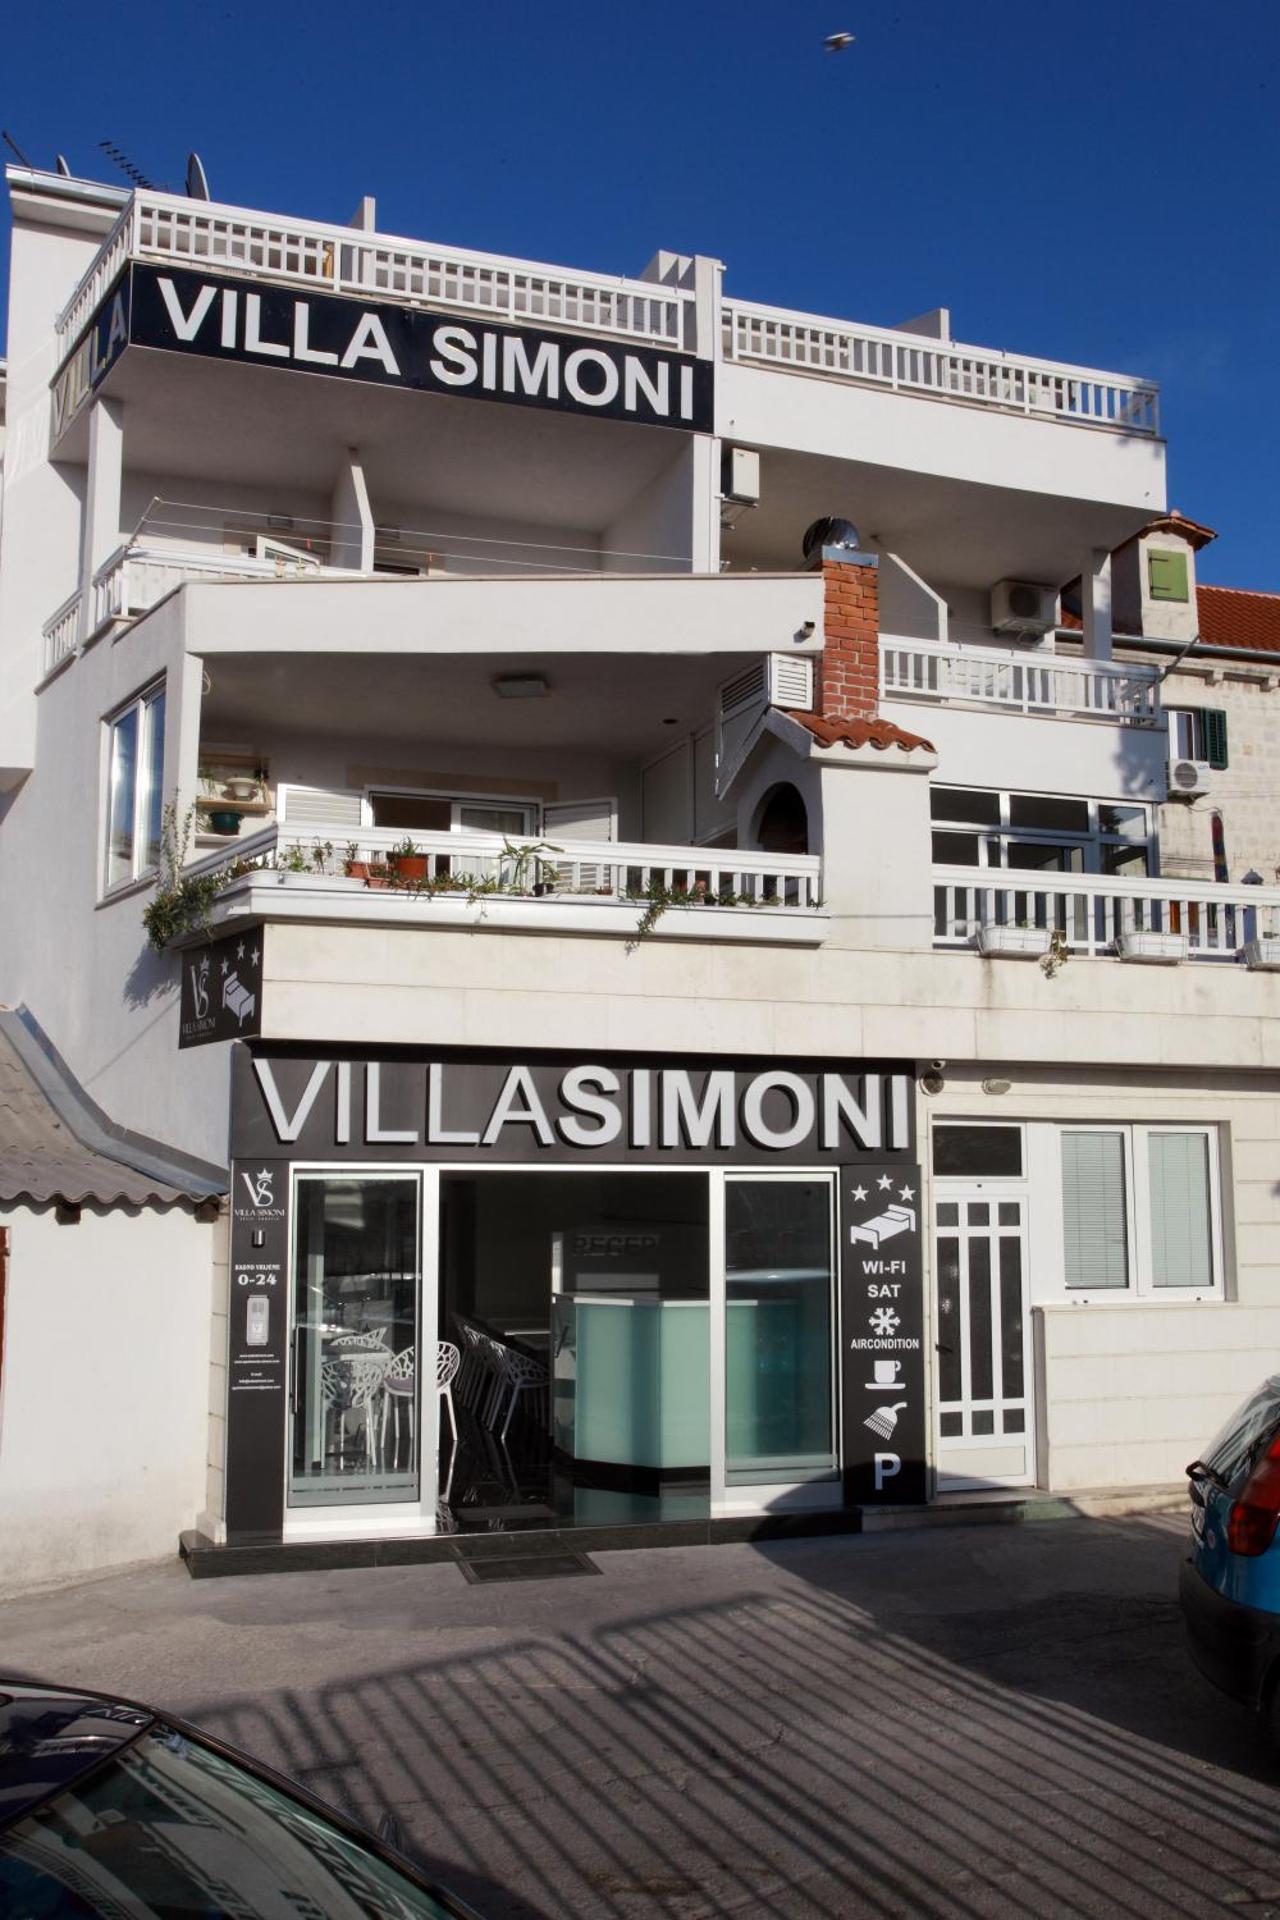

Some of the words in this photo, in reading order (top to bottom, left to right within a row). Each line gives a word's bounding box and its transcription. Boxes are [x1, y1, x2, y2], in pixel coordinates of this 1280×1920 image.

[156, 277, 401, 376] VILLA
[430, 326, 693, 420] SIMONI
[862, 1260, 906, 1274] WI-FI
[238, 1273, 277, 1286] 0-24
[867, 1284, 901, 1298] SAT
[851, 1338, 919, 1349] AIRCONDITION
[874, 1453, 901, 1490] P
